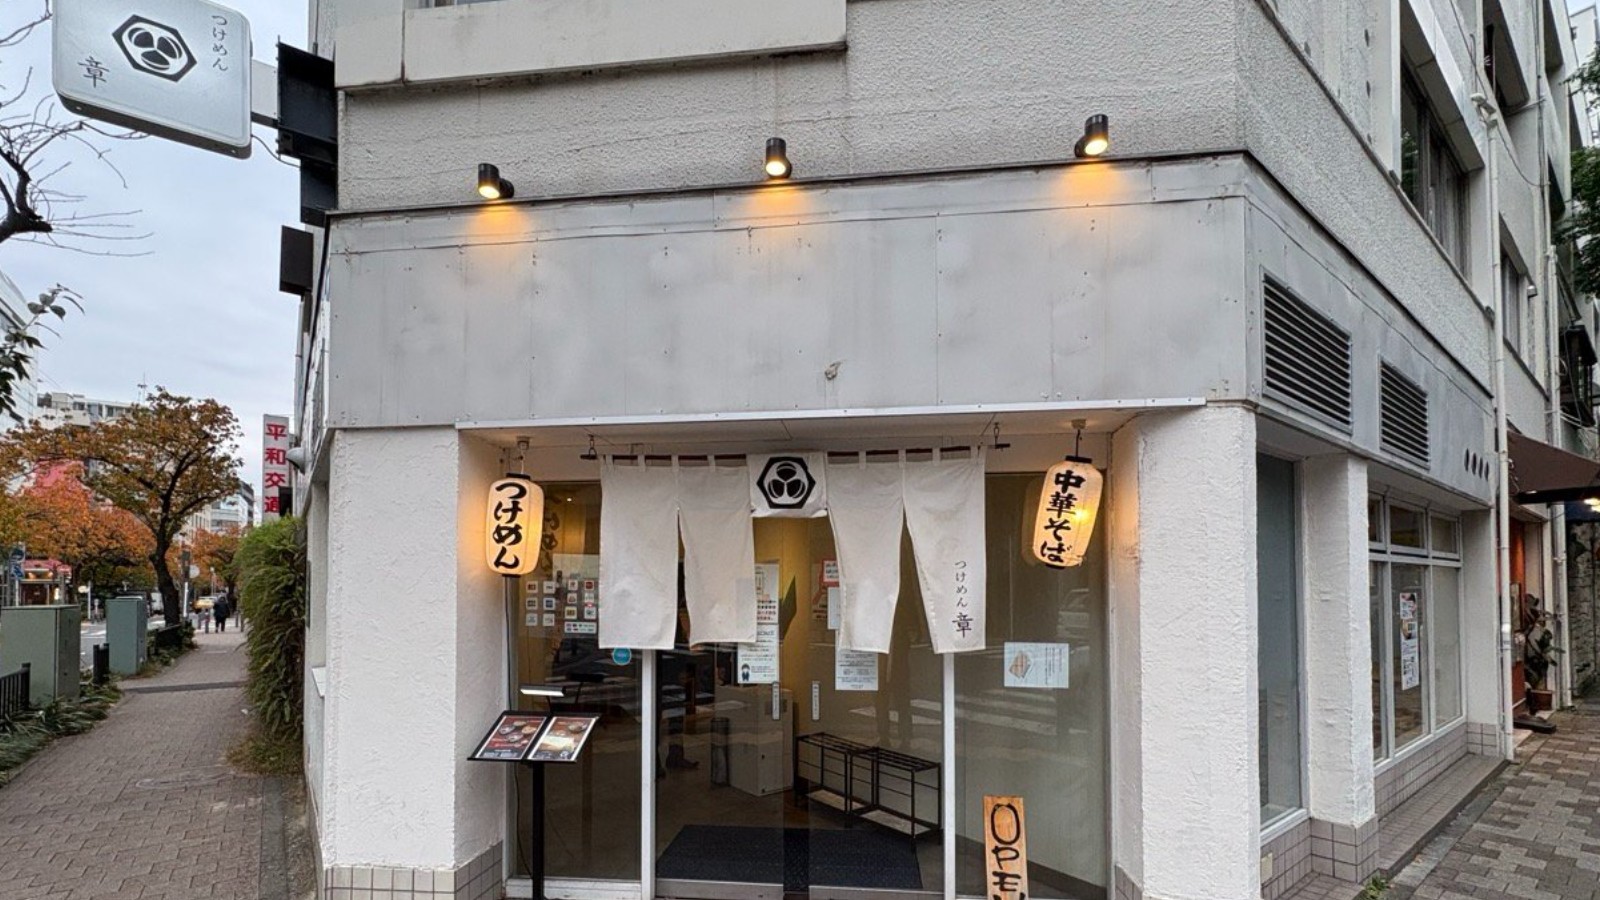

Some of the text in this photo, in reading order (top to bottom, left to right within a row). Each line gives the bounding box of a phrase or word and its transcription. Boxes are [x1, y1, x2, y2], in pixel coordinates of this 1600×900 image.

[78, 55, 110, 88] 章
[211, 15, 229, 72] つけめん
[264, 423, 288, 513] 平和交通
[492, 481, 527, 570] つけめん
[1040, 469, 1086, 564] 中華そば
[951, 560, 974, 638] つけめん 章
